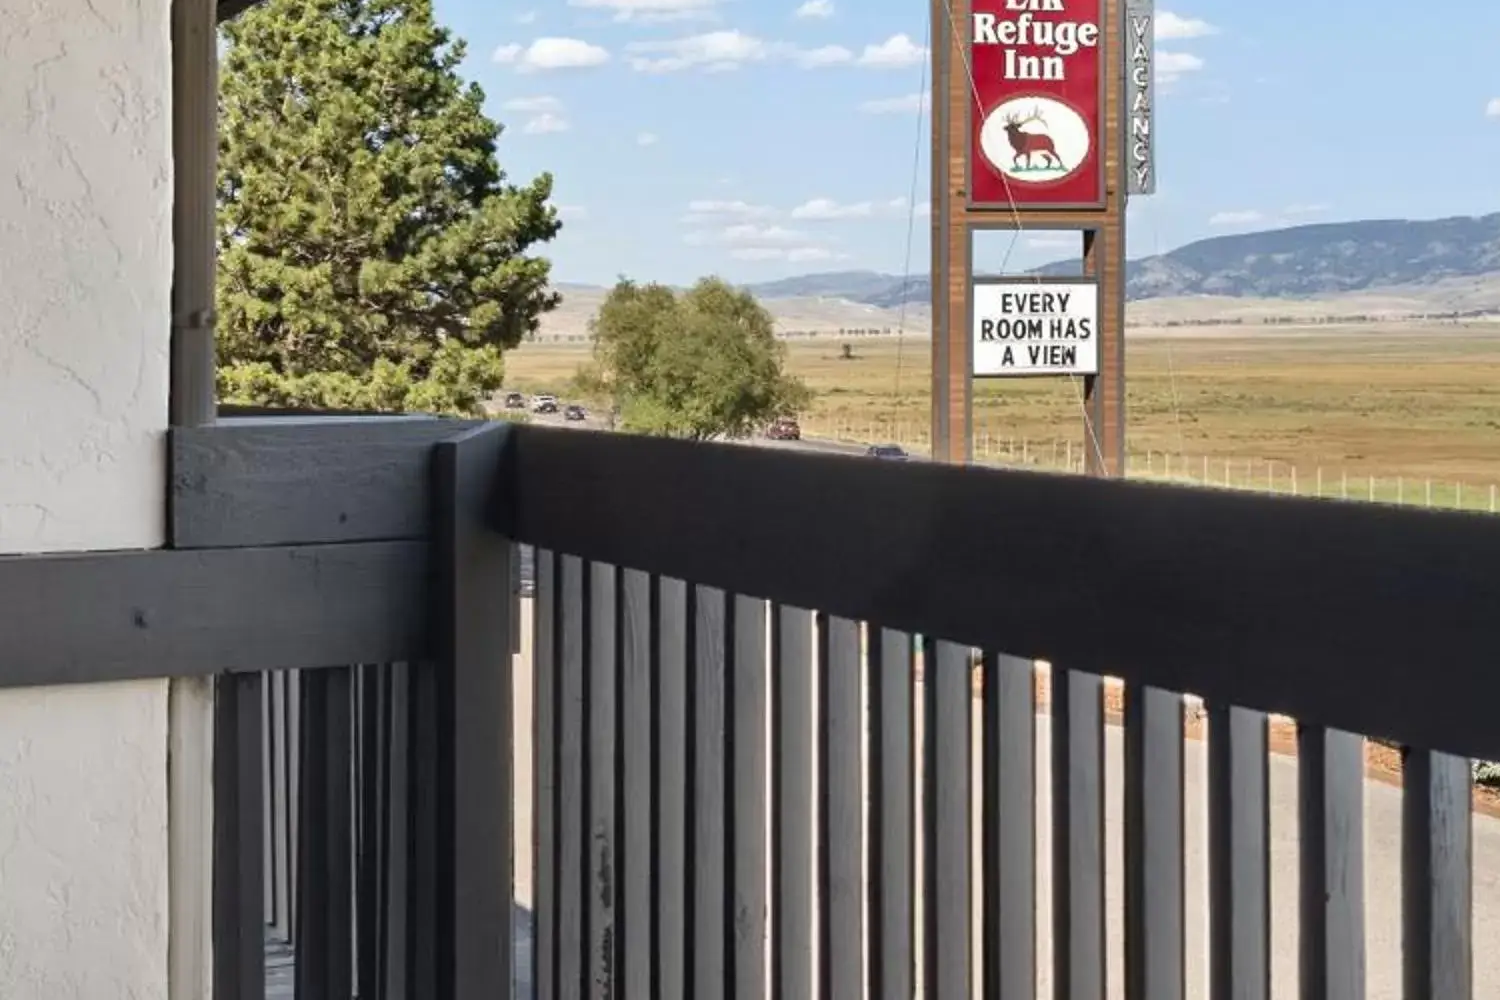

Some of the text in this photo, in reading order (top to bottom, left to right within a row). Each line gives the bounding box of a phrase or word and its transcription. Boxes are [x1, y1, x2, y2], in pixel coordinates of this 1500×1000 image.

[972, 13, 1099, 54] Refuge
[1003, 49, 1065, 81] Inn
[1131, 15, 1151, 188] VACANCY
[1001, 293, 1070, 313] EVERY
[981, 318, 1091, 339] ROOM HAS
[1001, 345, 1076, 366] A VIEW
